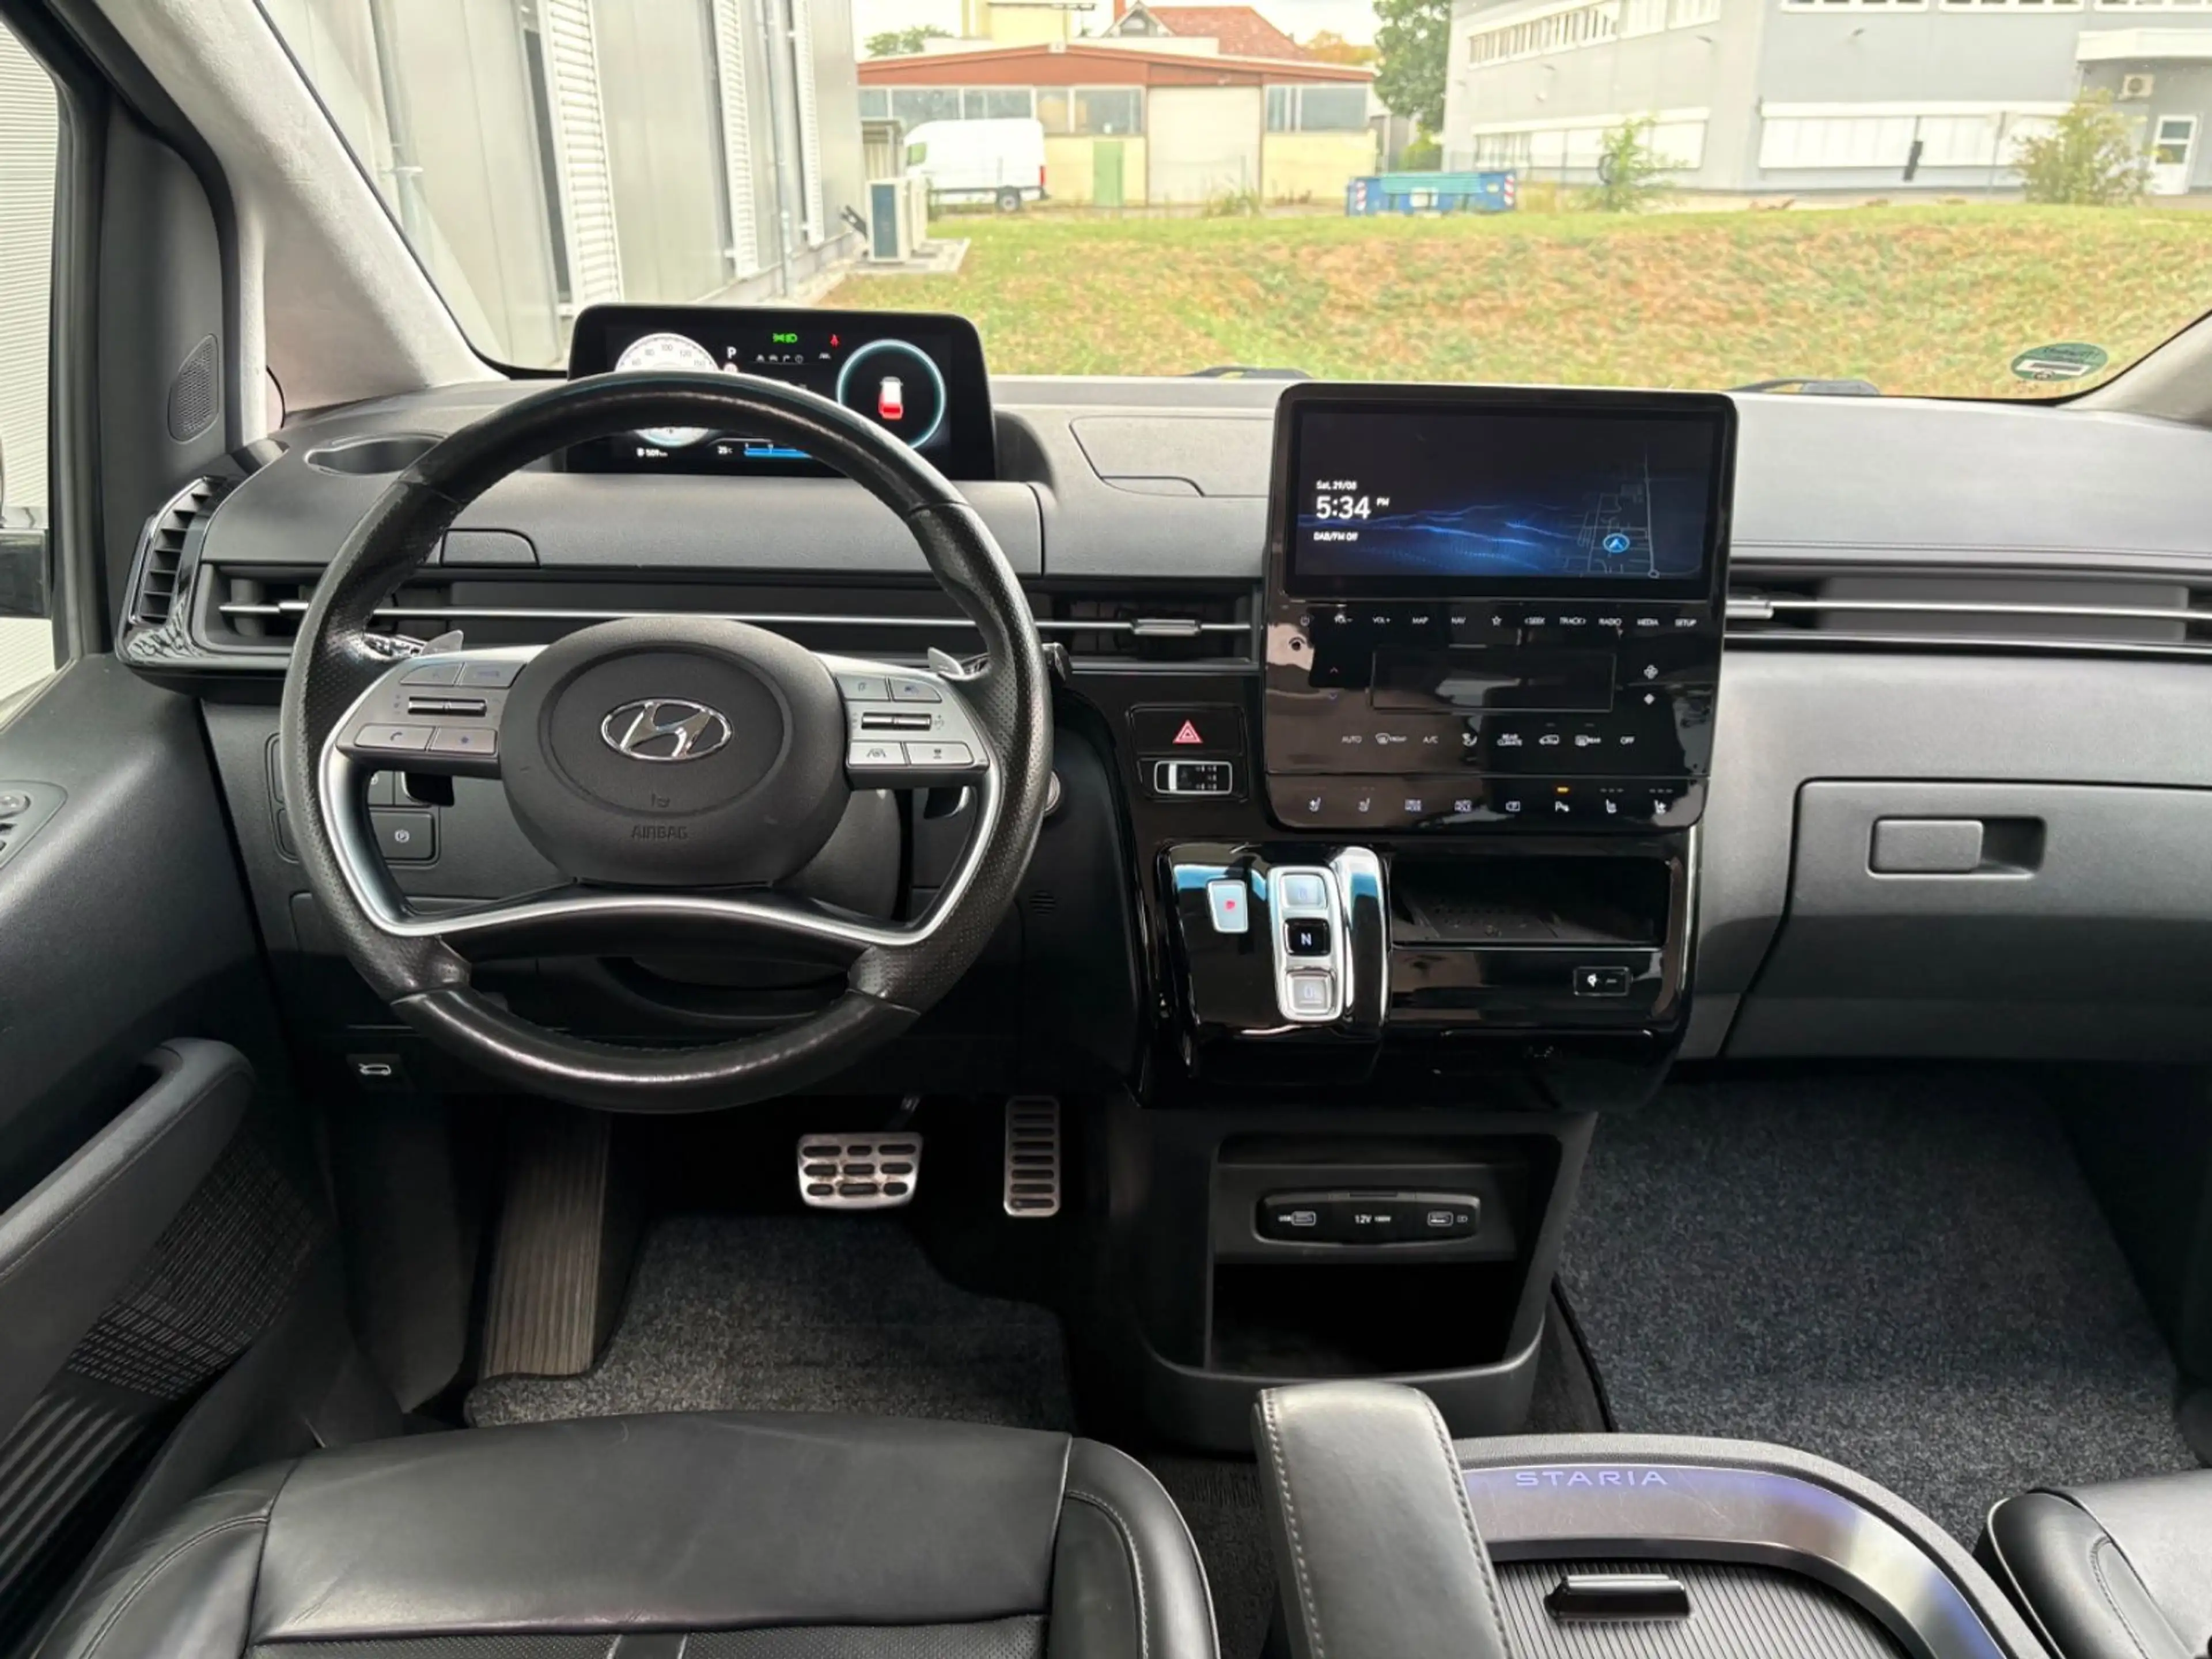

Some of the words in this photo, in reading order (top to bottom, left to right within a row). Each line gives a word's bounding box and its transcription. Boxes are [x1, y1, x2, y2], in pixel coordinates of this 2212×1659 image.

[726, 346, 737, 359] P
[1316, 495, 1372, 520] 5:34
[1376, 497, 1390, 507] PM
[1412, 616, 1429, 624] MAP
[1599, 618, 1622, 626] RADIO
[1637, 618, 1660, 626] MEDIA
[1675, 618, 1697, 627] SETUP
[1342, 735, 1362, 744] AUTO
[1423, 735, 1439, 744] A/C
[631, 824, 688, 839] AIRBAG
[1301, 933, 1312, 946] N
[1354, 1214, 1372, 1225] 12V
[1516, 1471, 1669, 1486] STARIA
